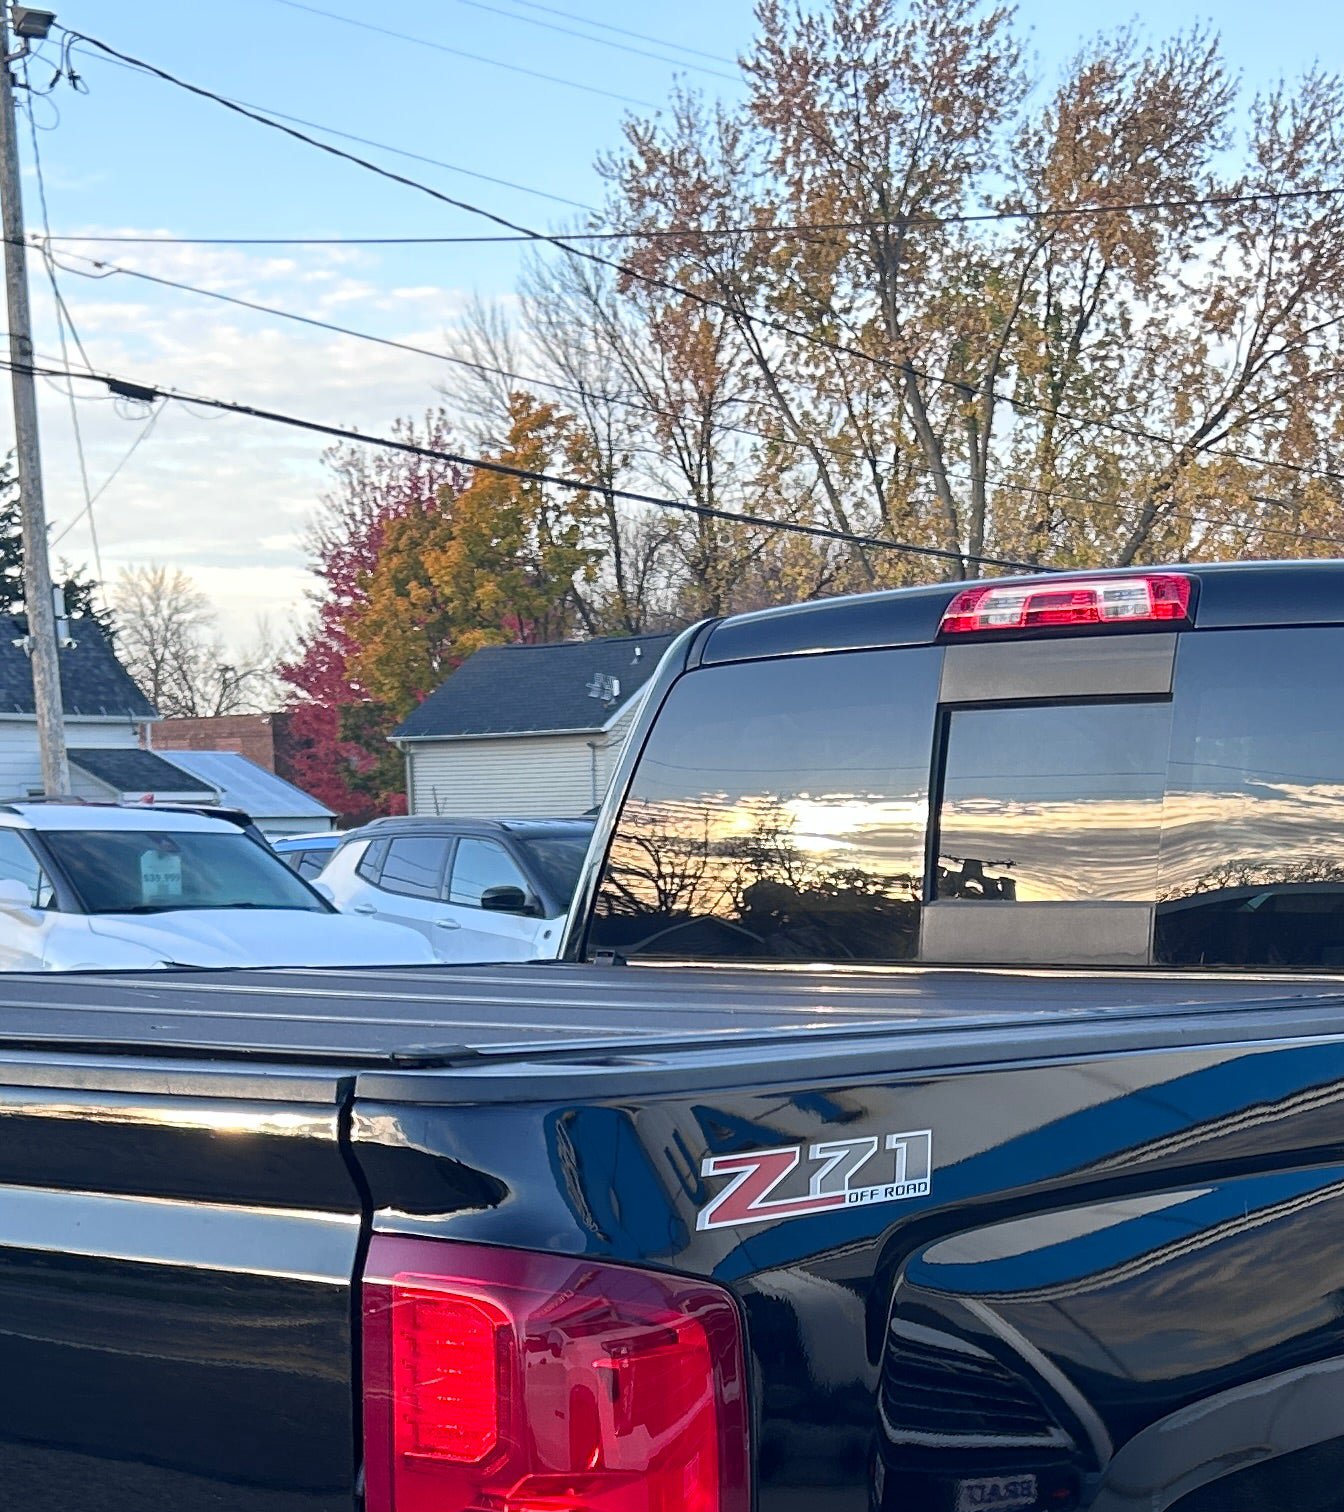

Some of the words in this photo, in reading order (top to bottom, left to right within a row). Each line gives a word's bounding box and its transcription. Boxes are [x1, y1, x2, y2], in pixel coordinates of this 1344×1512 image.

[696, 1129, 932, 1231] Z71
[848, 1189, 880, 1204] OFF
[884, 1181, 928, 1199] ROAD
